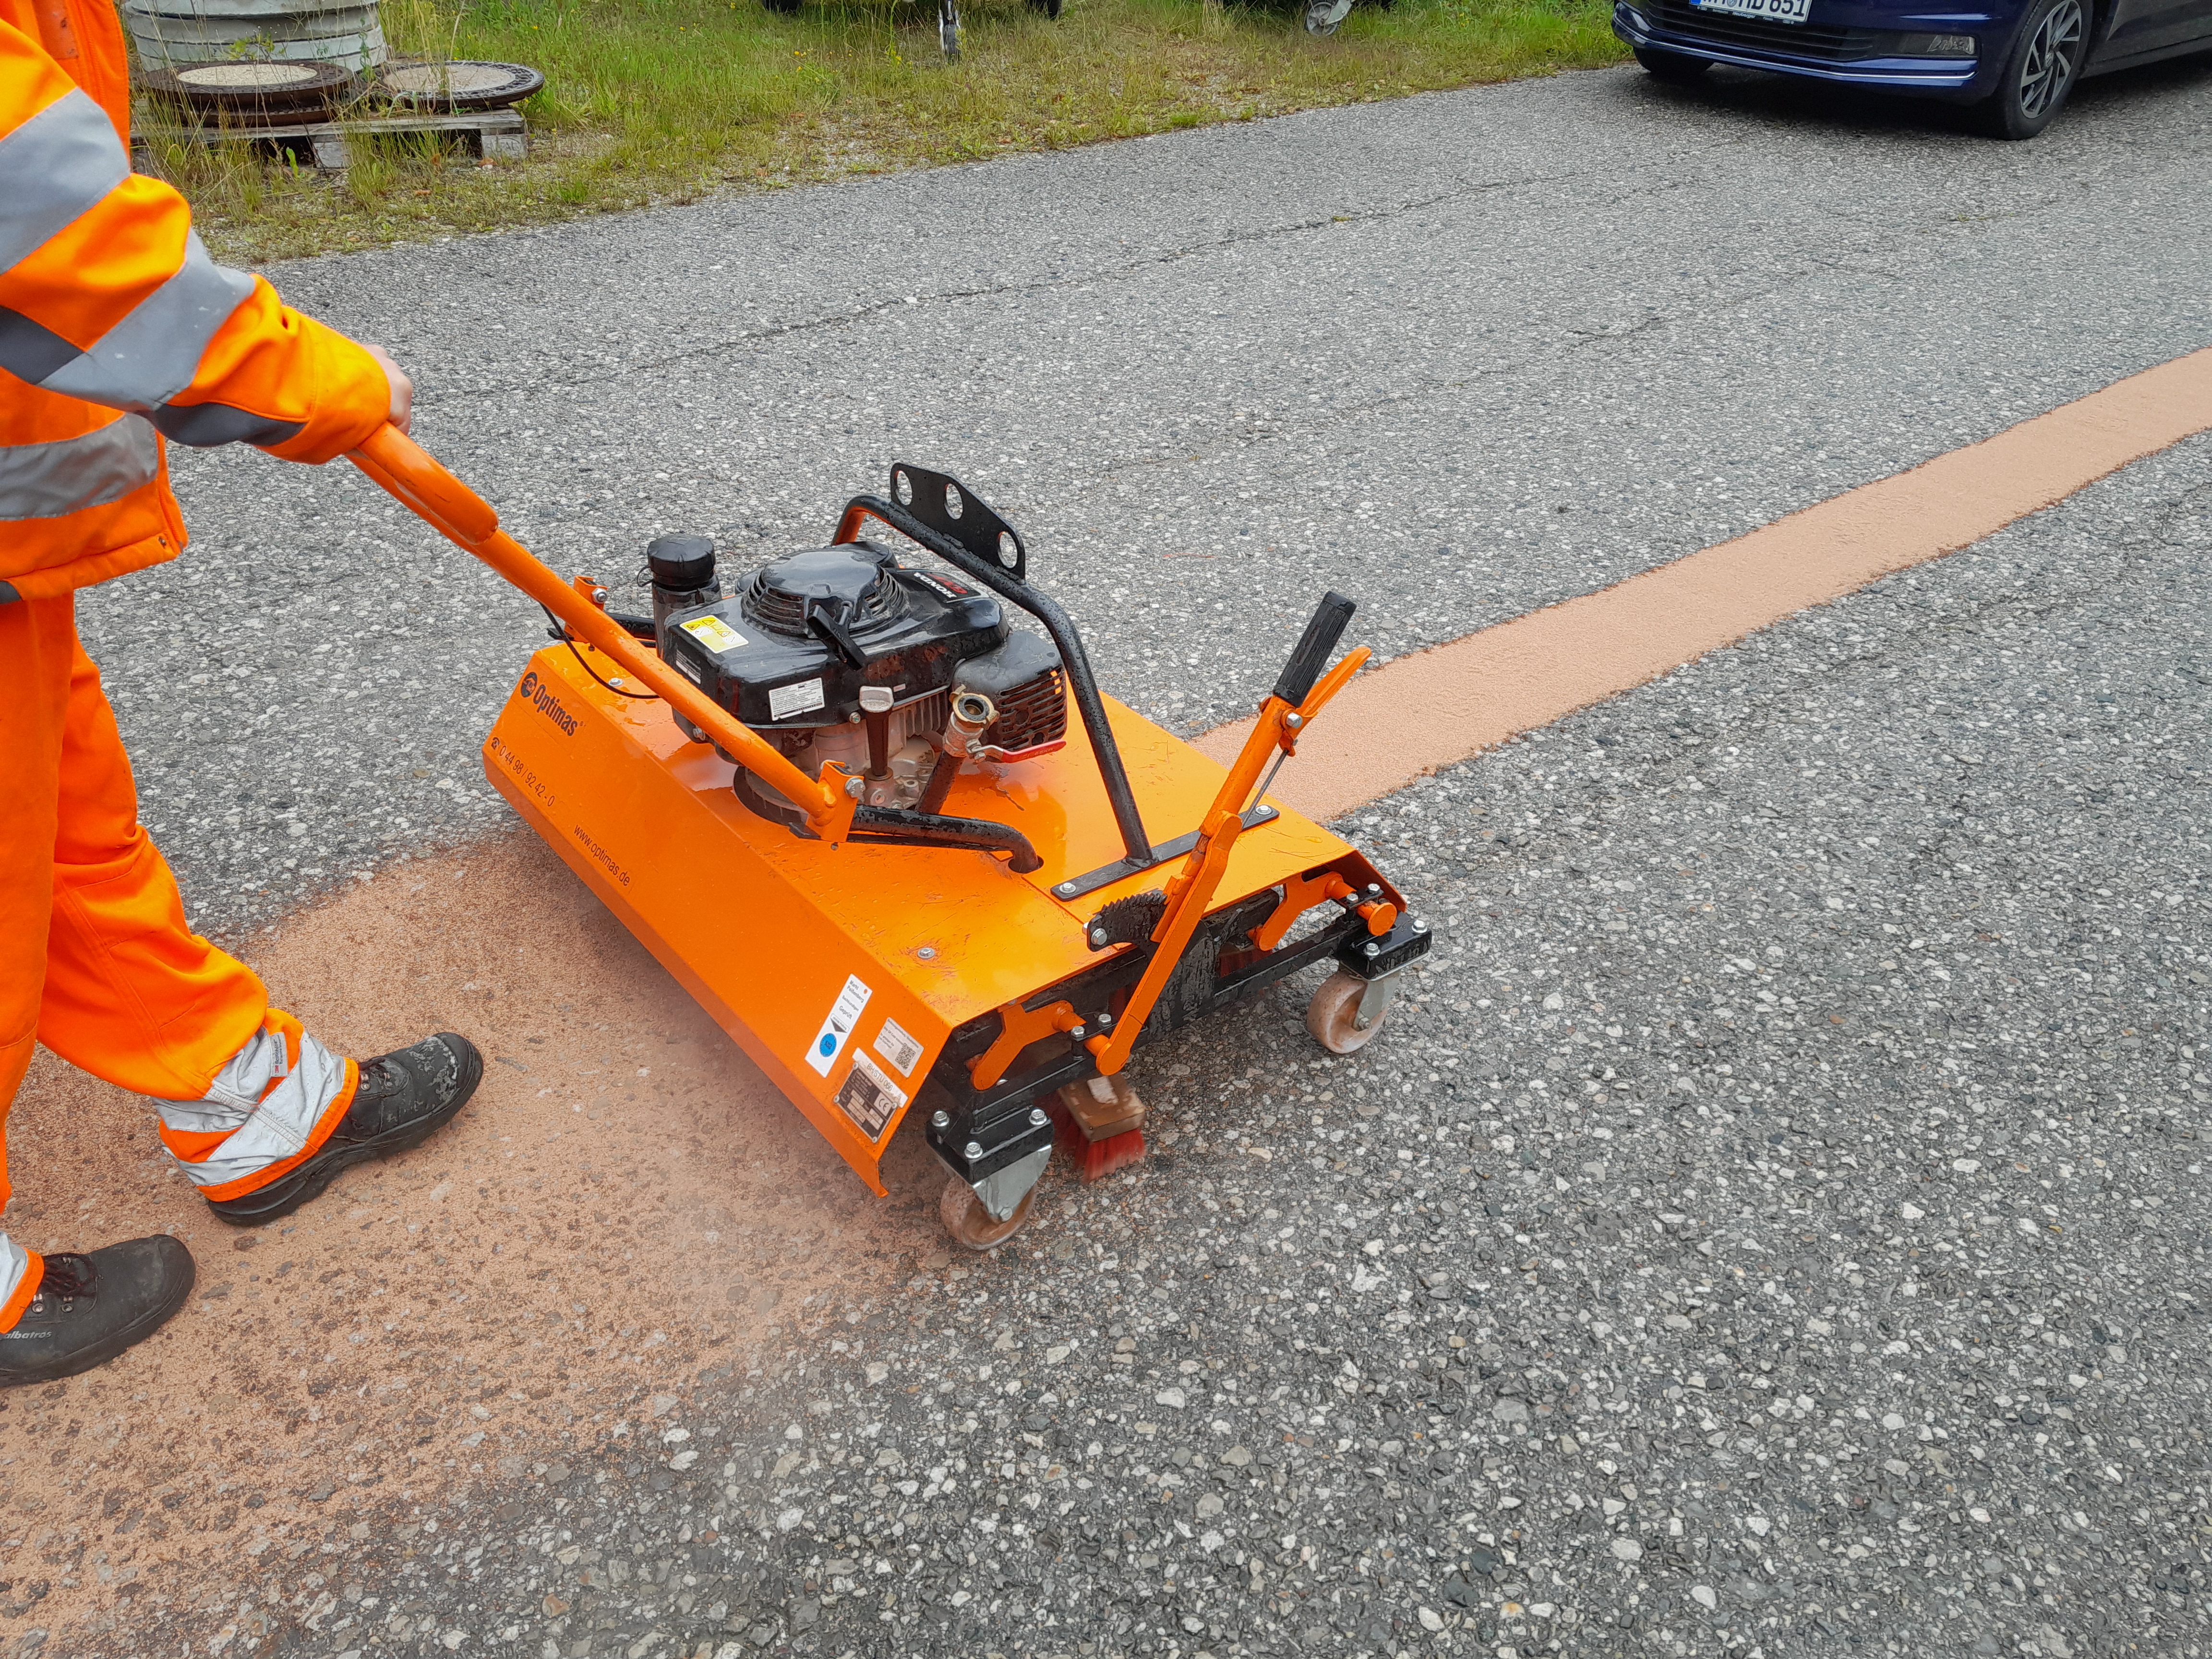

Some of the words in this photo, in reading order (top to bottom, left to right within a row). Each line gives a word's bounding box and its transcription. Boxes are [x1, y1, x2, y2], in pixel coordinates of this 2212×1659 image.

[914, 572, 957, 598] HONDA
[533, 684, 578, 736] Optimas
[499, 745, 506, 756] 0
[505, 751, 516, 765] 44
[513, 759, 524, 774] 98
[525, 772, 537, 788] 92
[534, 782, 546, 798] 42
[547, 795, 555, 806] 0
[574, 824, 630, 886] www.optimas.de
[5, 1330, 52, 1339] albatros
